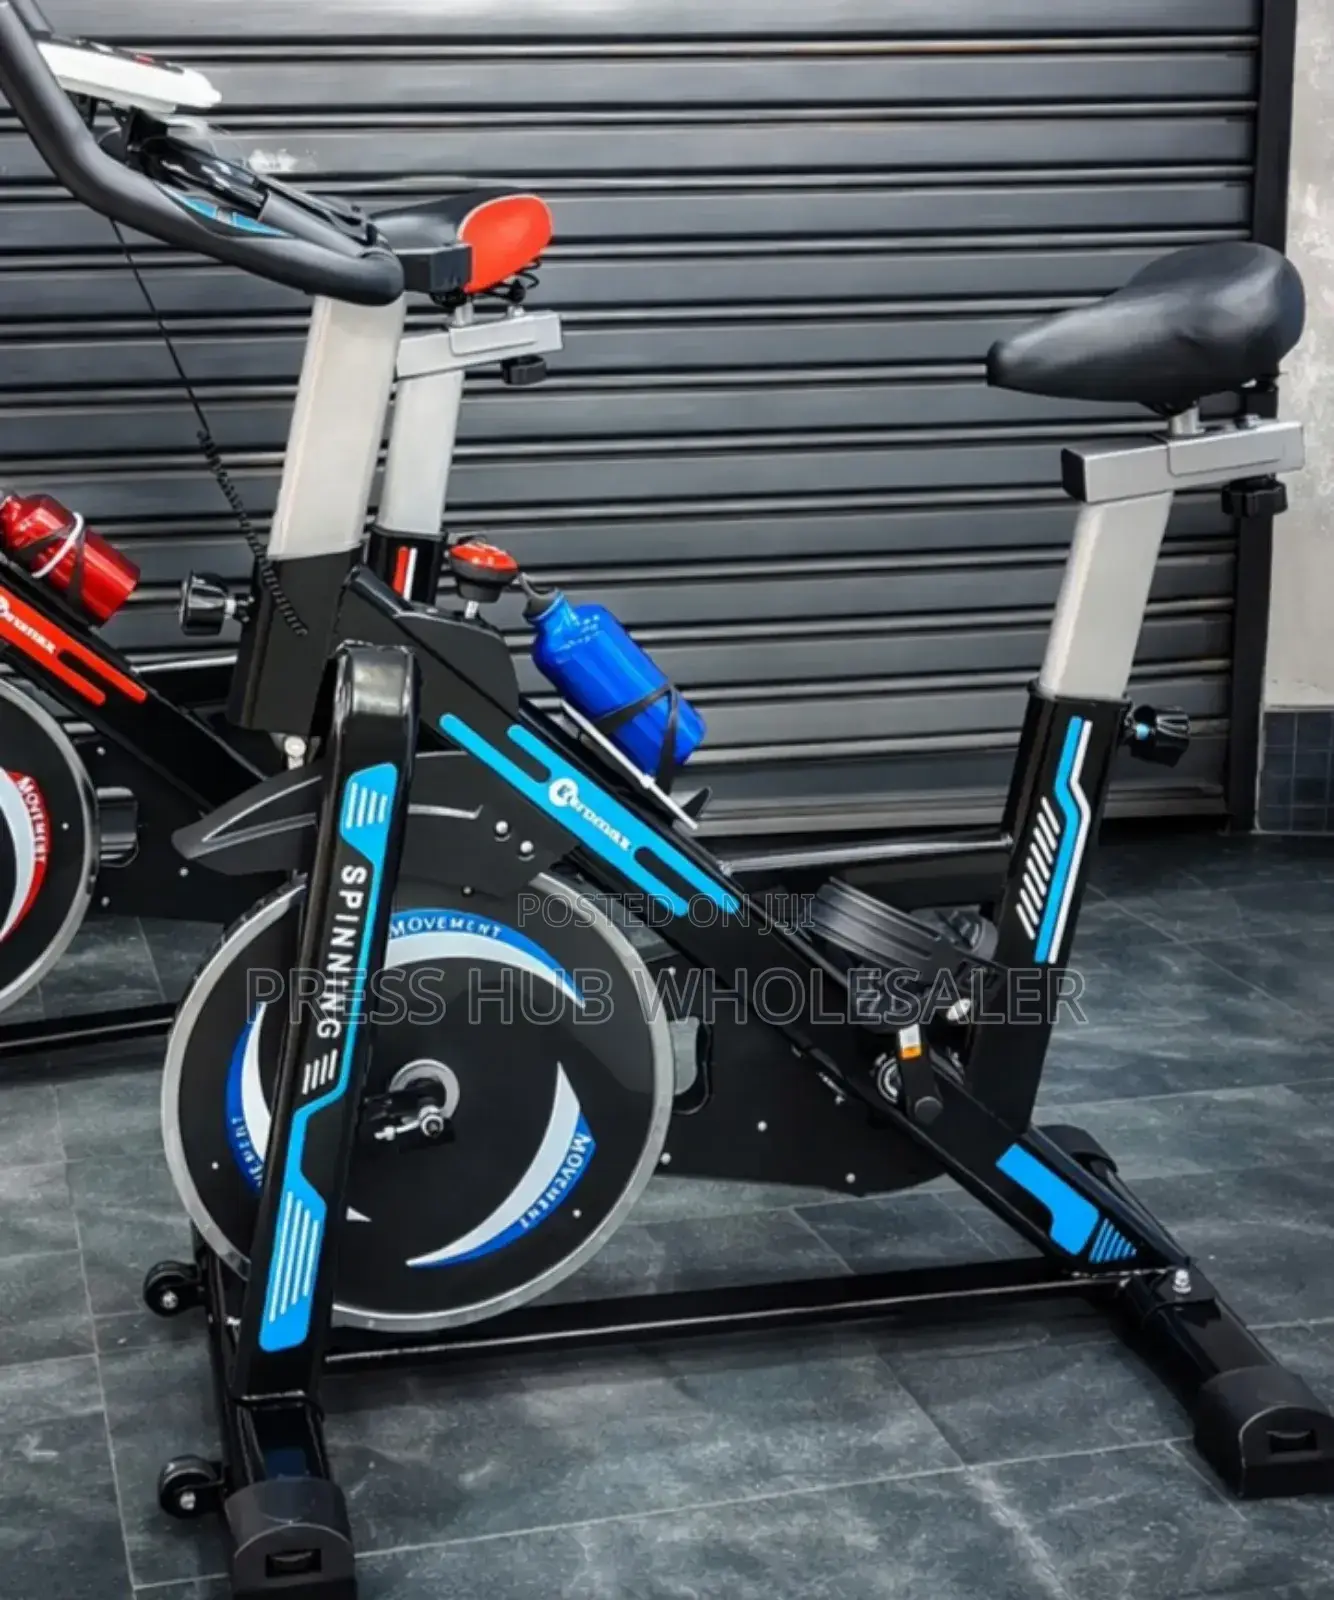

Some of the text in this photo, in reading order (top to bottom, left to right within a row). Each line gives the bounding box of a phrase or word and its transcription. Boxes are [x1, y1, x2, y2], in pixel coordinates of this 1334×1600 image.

[17, 775, 47, 863] MOVEMENT
[316, 865, 368, 1040] SPINNING
[388, 916, 502, 940] MOVEMENT
[519, 1132, 592, 1229] MOVEMENT
